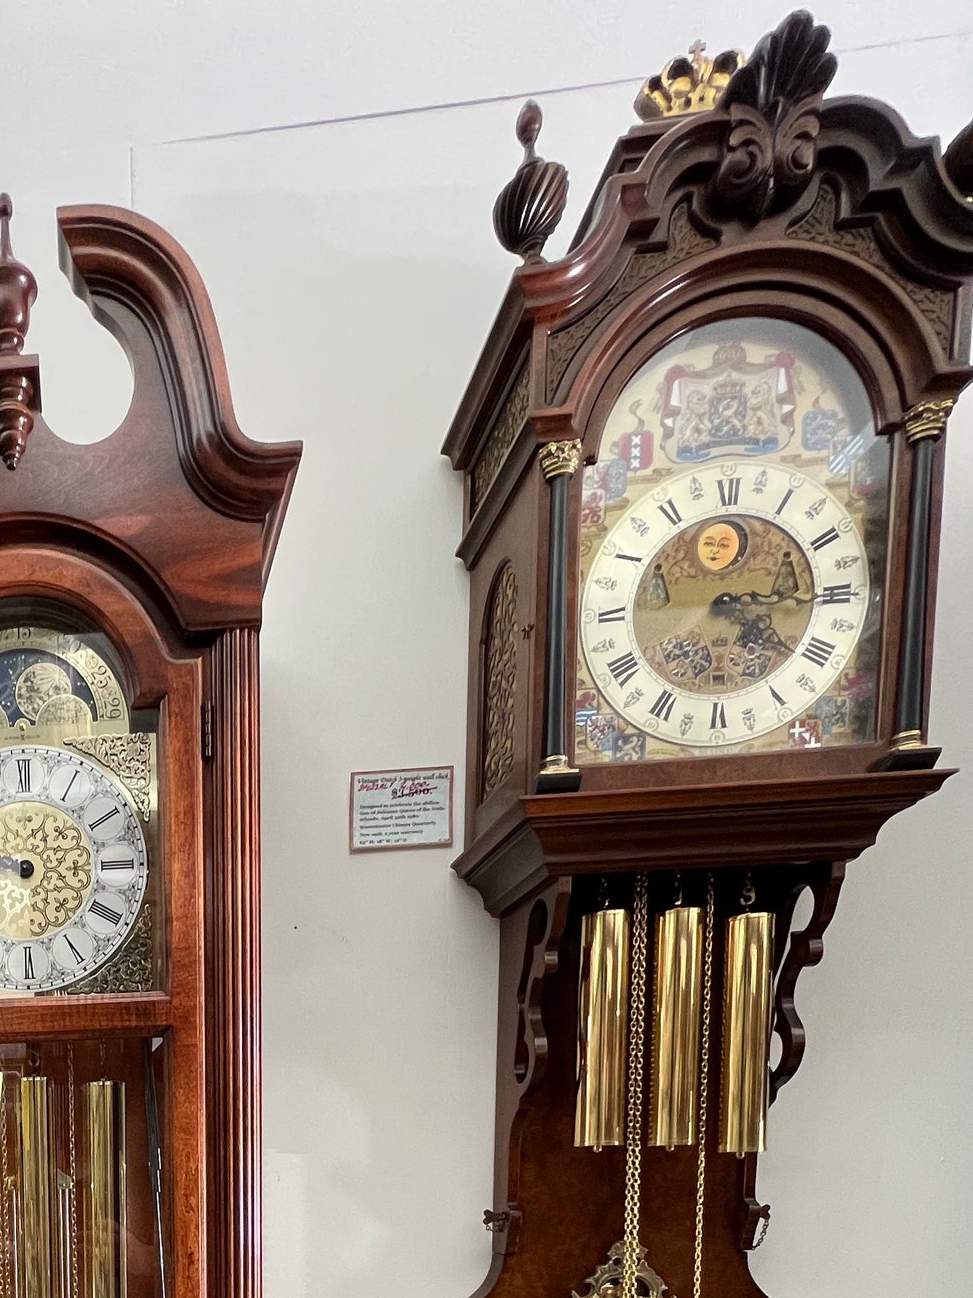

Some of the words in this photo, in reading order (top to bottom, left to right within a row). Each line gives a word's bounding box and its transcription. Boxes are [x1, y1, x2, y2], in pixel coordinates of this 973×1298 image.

[716, 477, 742, 507] XII
[775, 488, 794, 516] I
[810, 525, 840, 553] II
[823, 581, 852, 605] III
[16, 627, 32, 640] 15
[801, 636, 837, 670] IIII
[90, 665, 112, 689] 25
[607, 651, 641, 688] VIII
[103, 697, 122, 721] 29
[648, 689, 677, 722] VII
[15, 759, 32, 793] XII
[61, 770, 81, 802] I
[88, 806, 121, 832] II
[100, 858, 135, 872] III
[88, 899, 123, 926] IIII
[22, 946, 36, 980] VI
[63, 933, 86, 965] V
